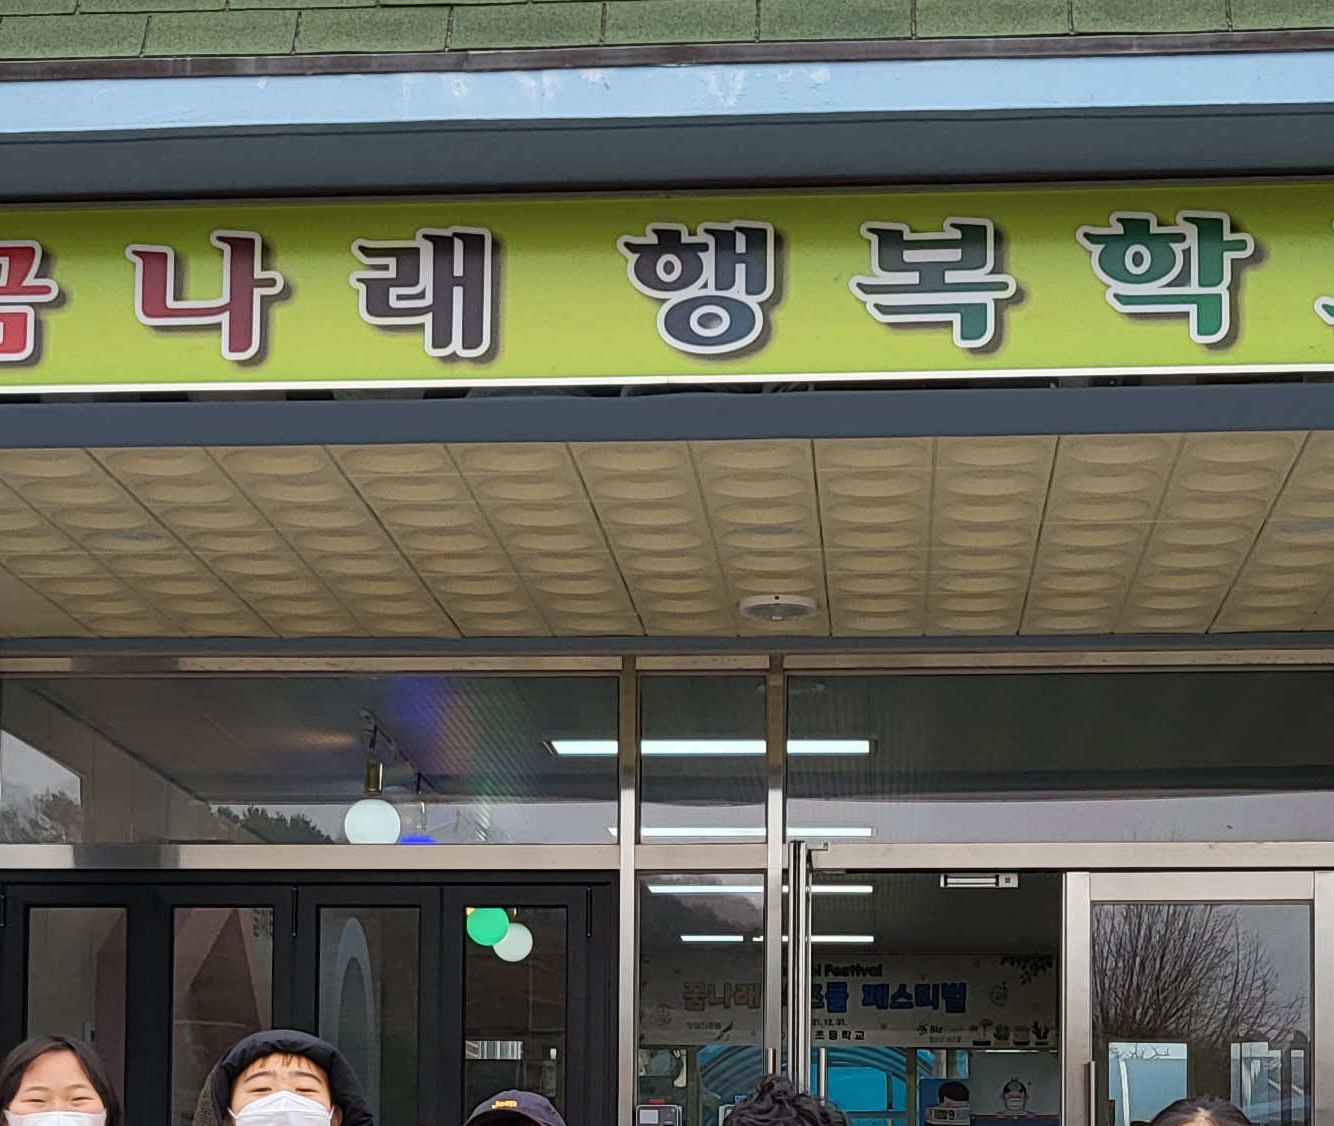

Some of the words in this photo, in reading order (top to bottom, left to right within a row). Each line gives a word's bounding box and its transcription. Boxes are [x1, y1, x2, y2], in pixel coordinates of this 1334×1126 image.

[824, 963, 883, 977] Festival
[683, 981, 761, 1011] 꿈나래
[862, 982, 966, 1013] 페스티벌
